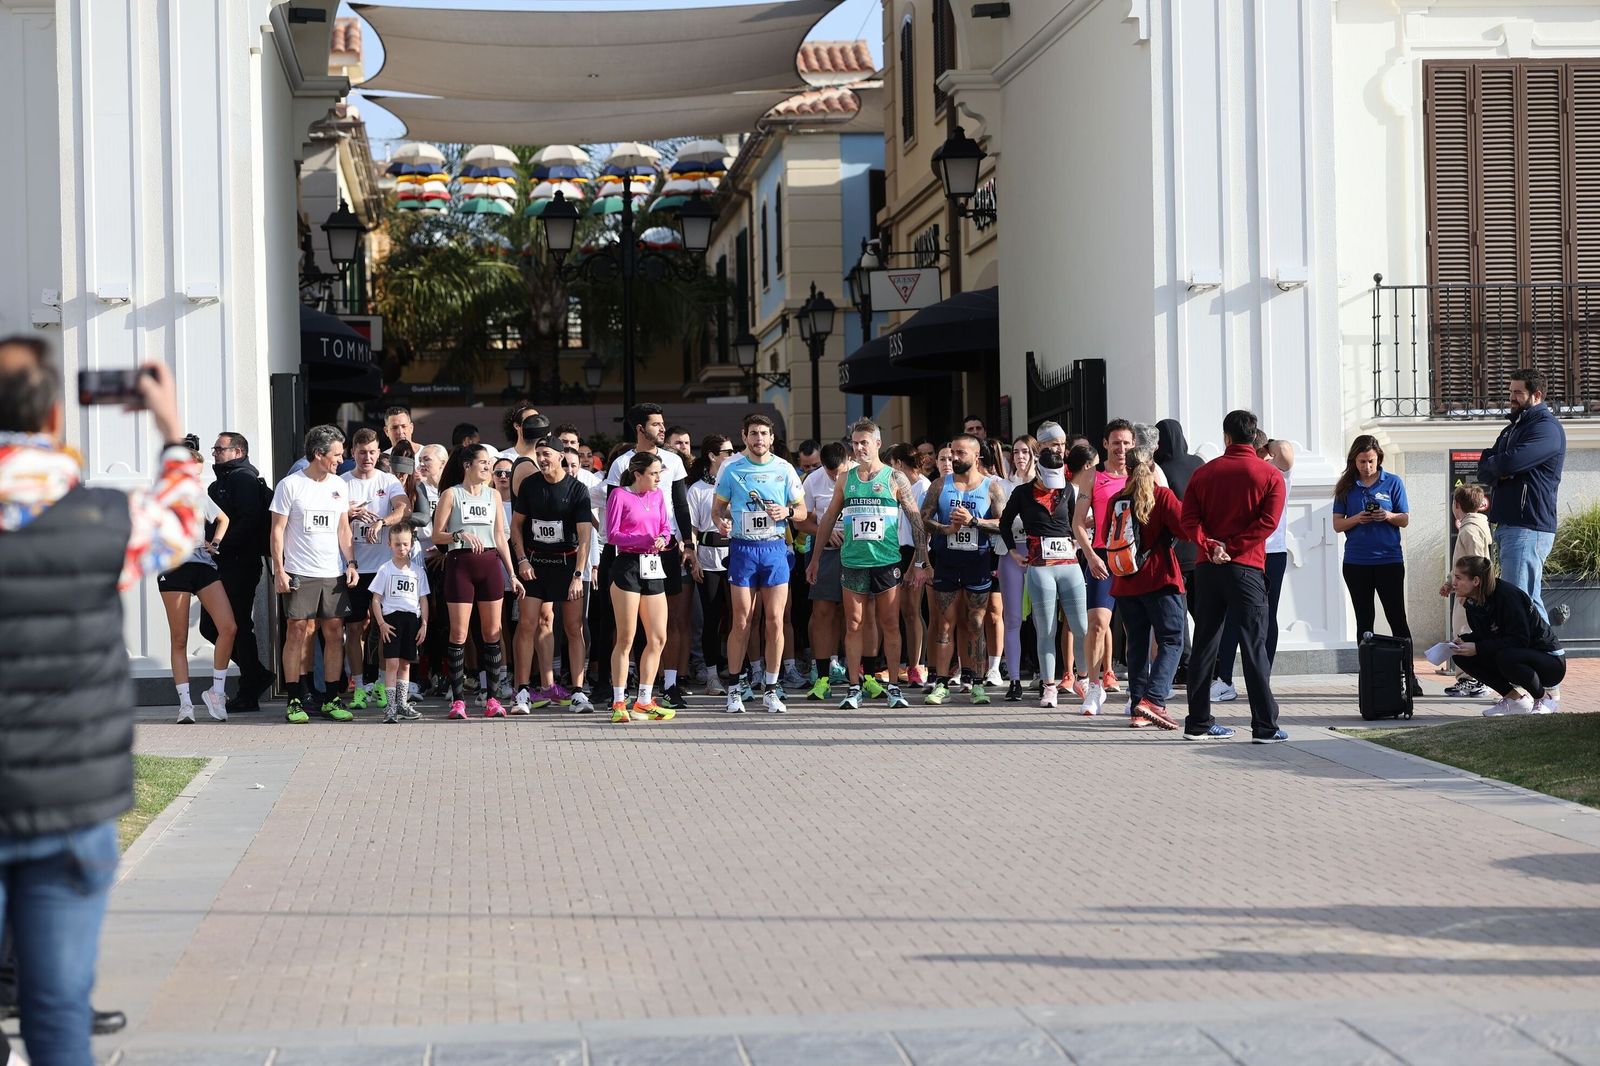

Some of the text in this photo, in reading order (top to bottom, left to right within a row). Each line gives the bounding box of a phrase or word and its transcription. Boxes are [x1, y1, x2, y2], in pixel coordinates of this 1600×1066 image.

[892, 277, 918, 285] GUESS
[434, 384, 460, 392] Services
[469, 506, 487, 516] 408
[312, 515, 329, 527] 501
[752, 516, 767, 528] 161
[860, 521, 876, 532] 179
[539, 526, 555, 537] 108
[955, 532, 970, 543] 169
[397, 580, 415, 592] 503
